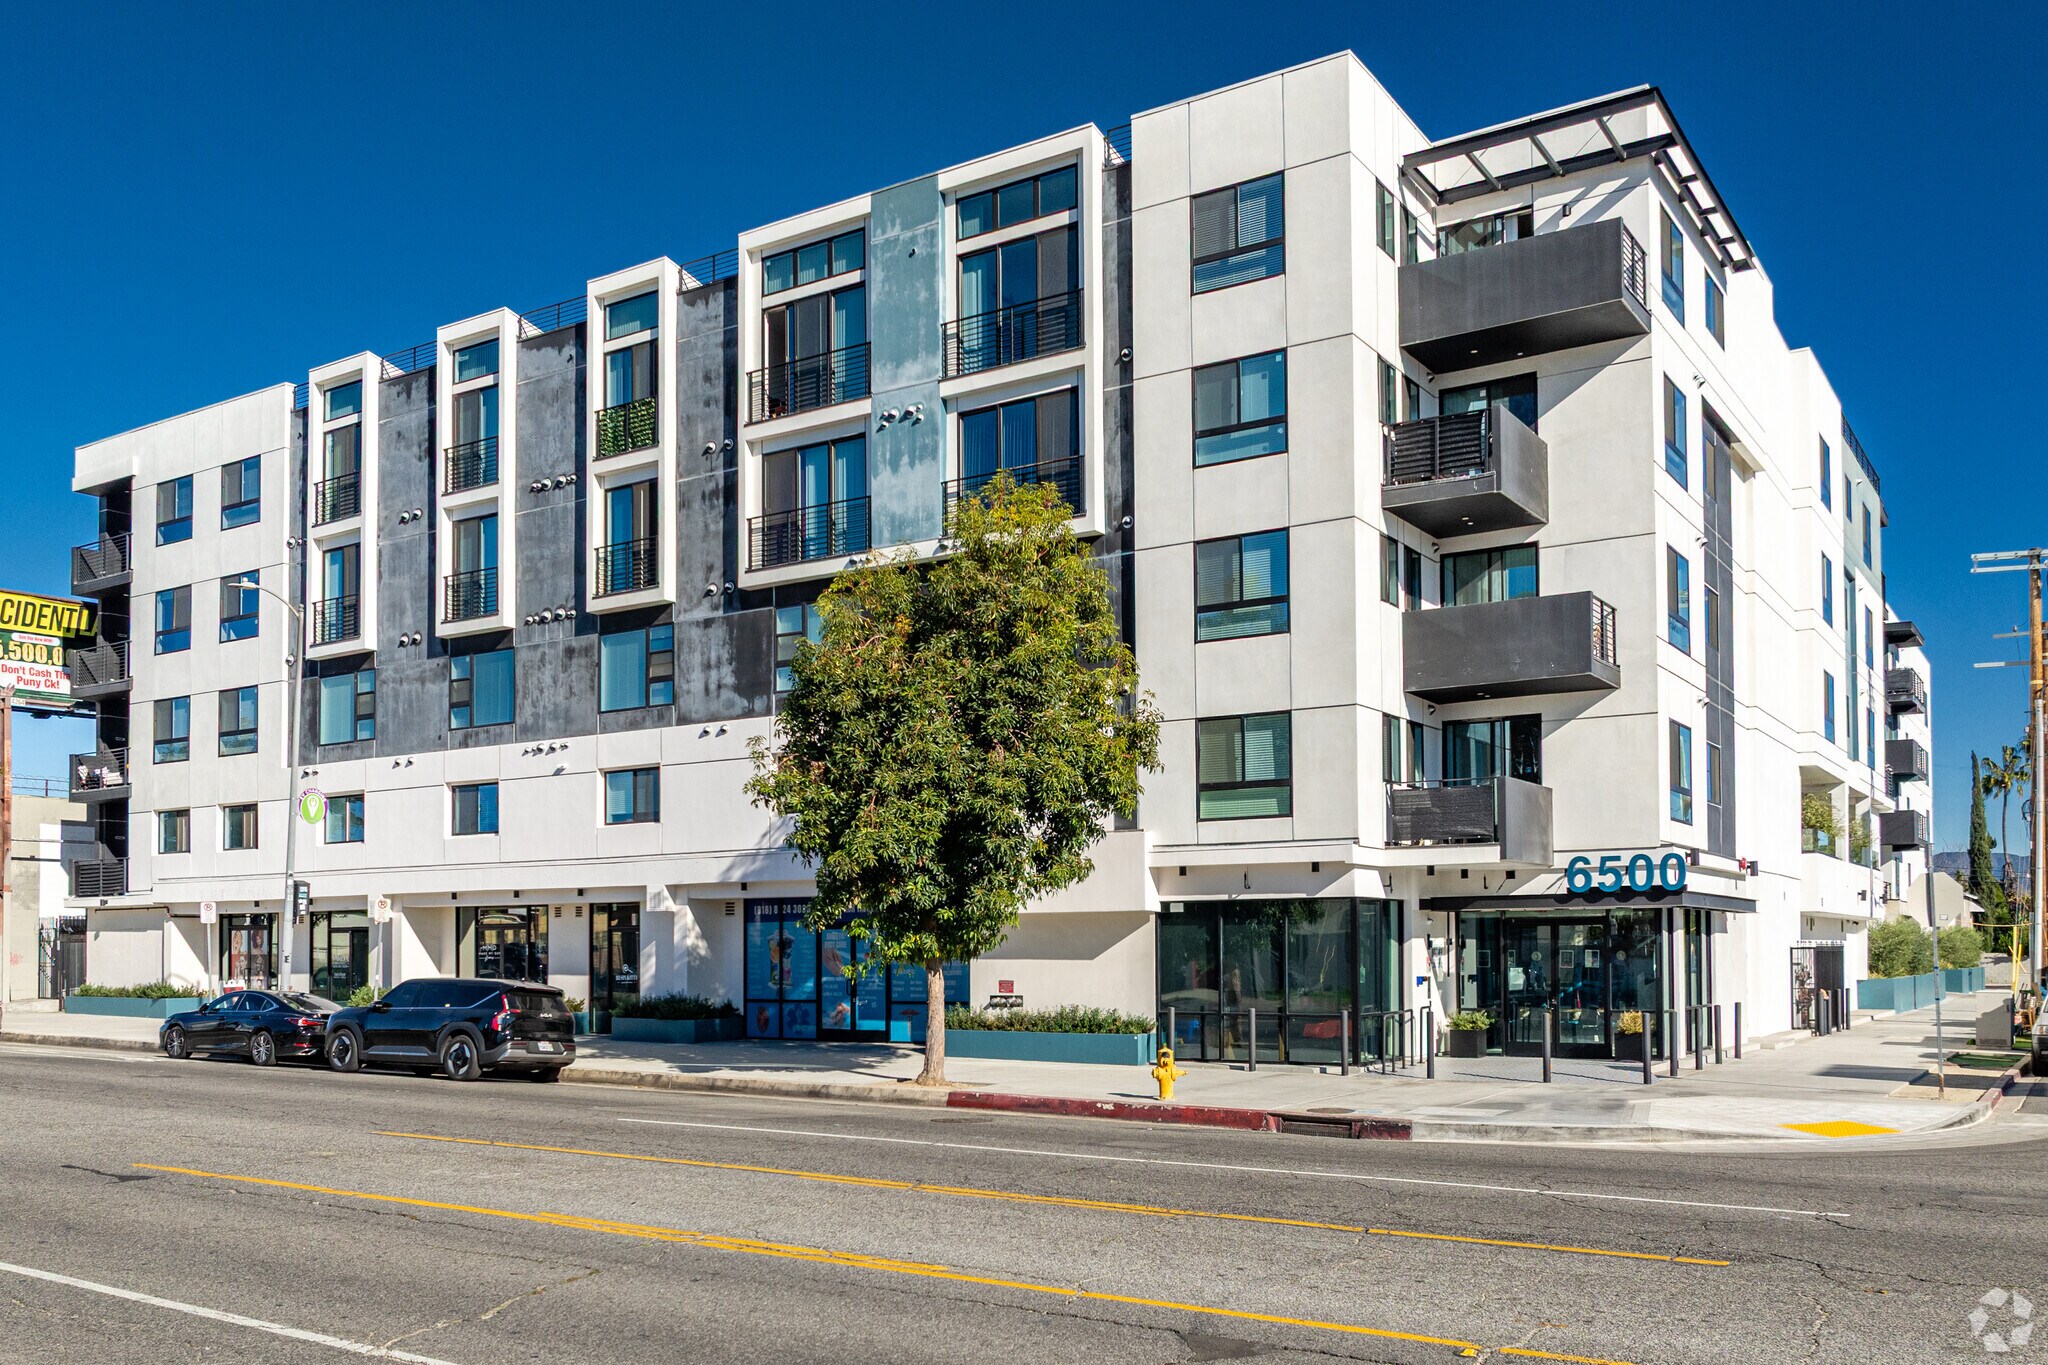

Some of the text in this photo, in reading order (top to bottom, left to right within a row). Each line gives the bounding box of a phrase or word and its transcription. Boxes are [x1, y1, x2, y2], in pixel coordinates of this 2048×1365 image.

[1, 663, 26, 675] Don't
[28, 667, 52, 678] Cash
[16, 675, 60, 690] Puny Ck!
[1566, 852, 1688, 893] 6500
